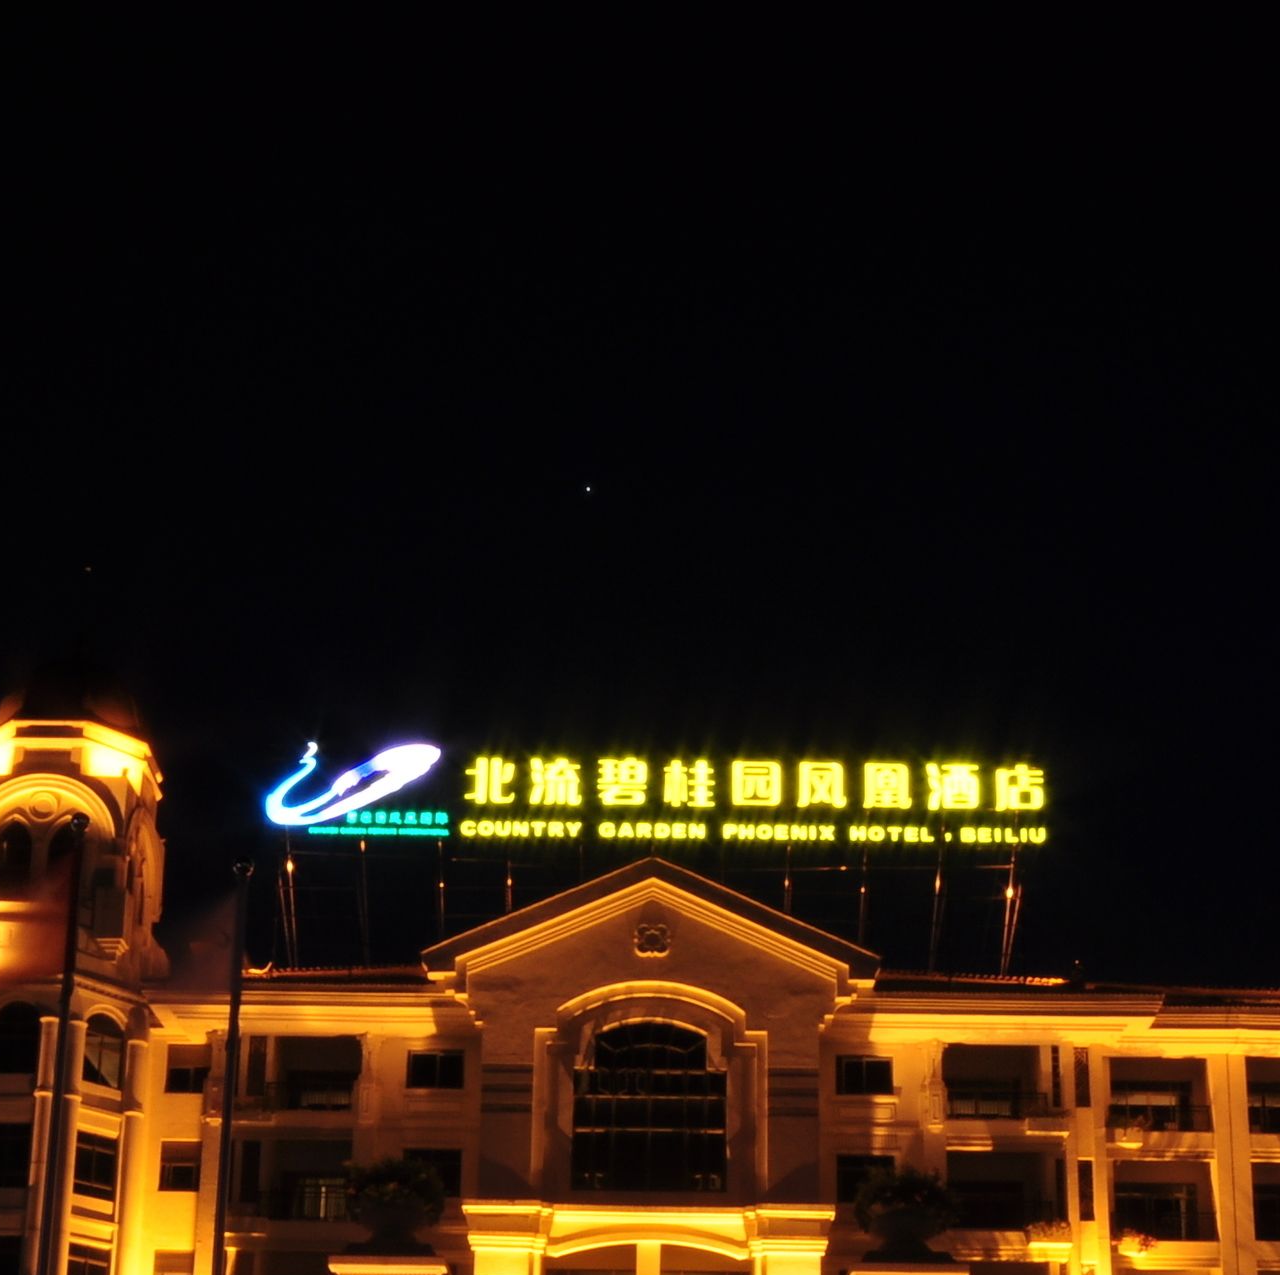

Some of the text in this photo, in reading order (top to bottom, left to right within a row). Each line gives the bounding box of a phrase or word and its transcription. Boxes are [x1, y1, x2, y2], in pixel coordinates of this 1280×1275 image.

[463, 755, 1046, 812] 北流碧桂园凤凰酒店
[459, 819, 582, 839] COUNTRY
[597, 821, 706, 840] GARDEN
[721, 821, 835, 842] PHOENIX
[959, 826, 1046, 844] BEILIU
